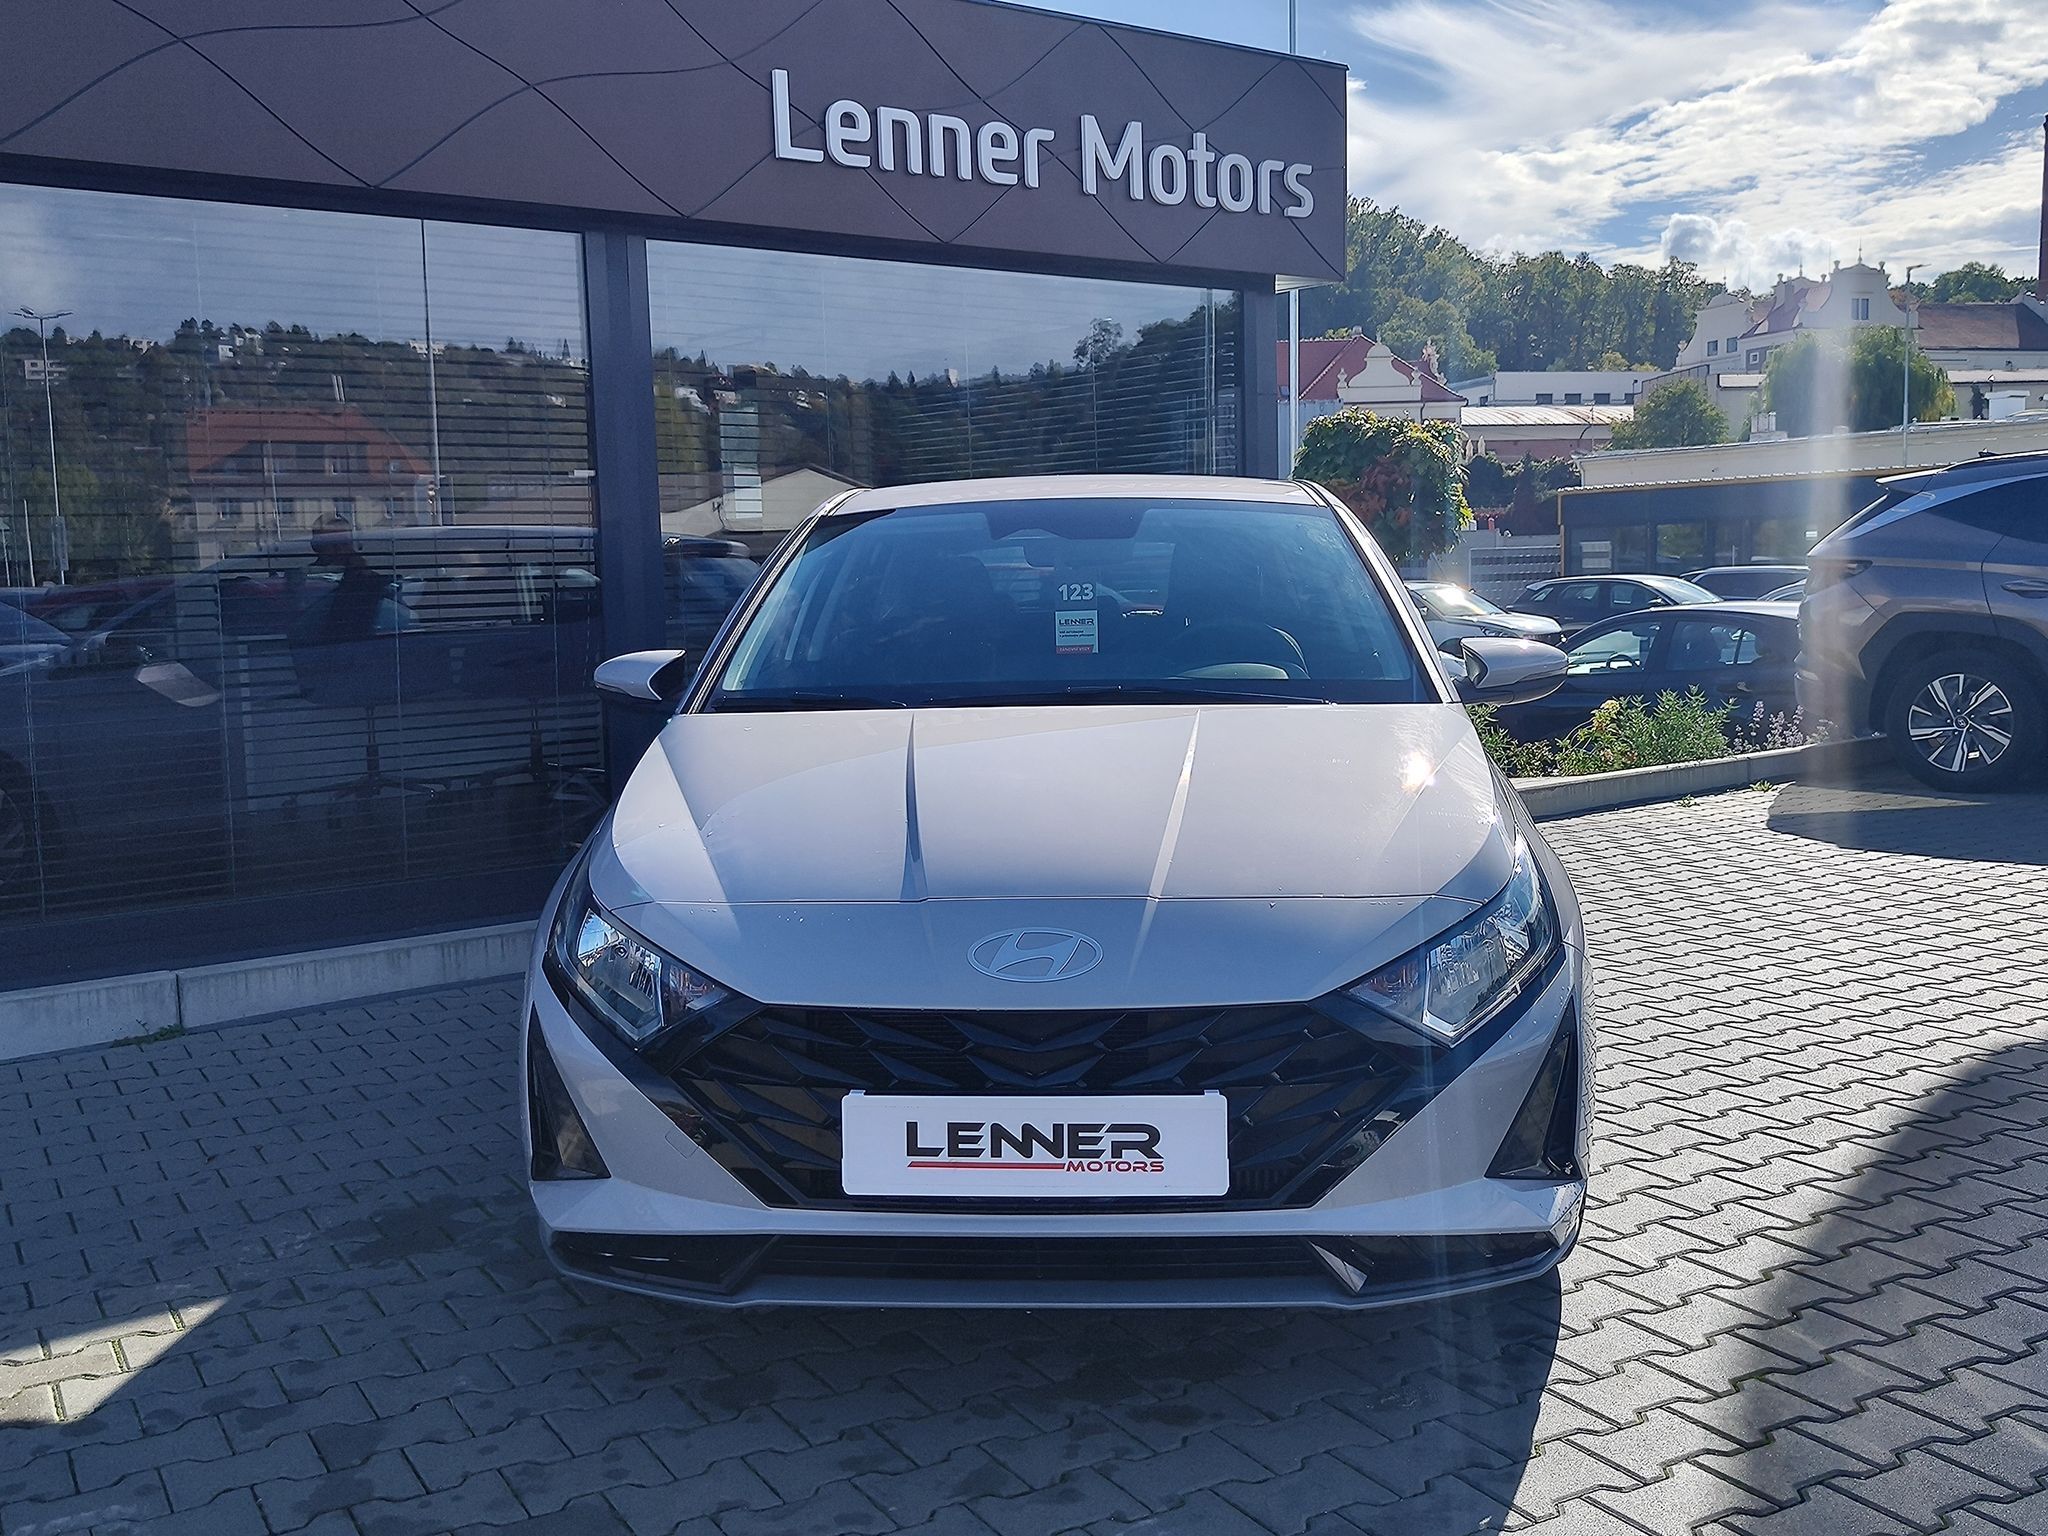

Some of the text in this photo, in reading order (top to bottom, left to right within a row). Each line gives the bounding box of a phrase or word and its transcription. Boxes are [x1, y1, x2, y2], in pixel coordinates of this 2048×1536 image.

[771, 68, 1315, 218] Lenner Motors
[1058, 583, 1094, 601] 123
[1058, 617, 1095, 626] LENNER
[906, 1121, 1165, 1159] LENNER
[1065, 1160, 1165, 1173] MOTORS
